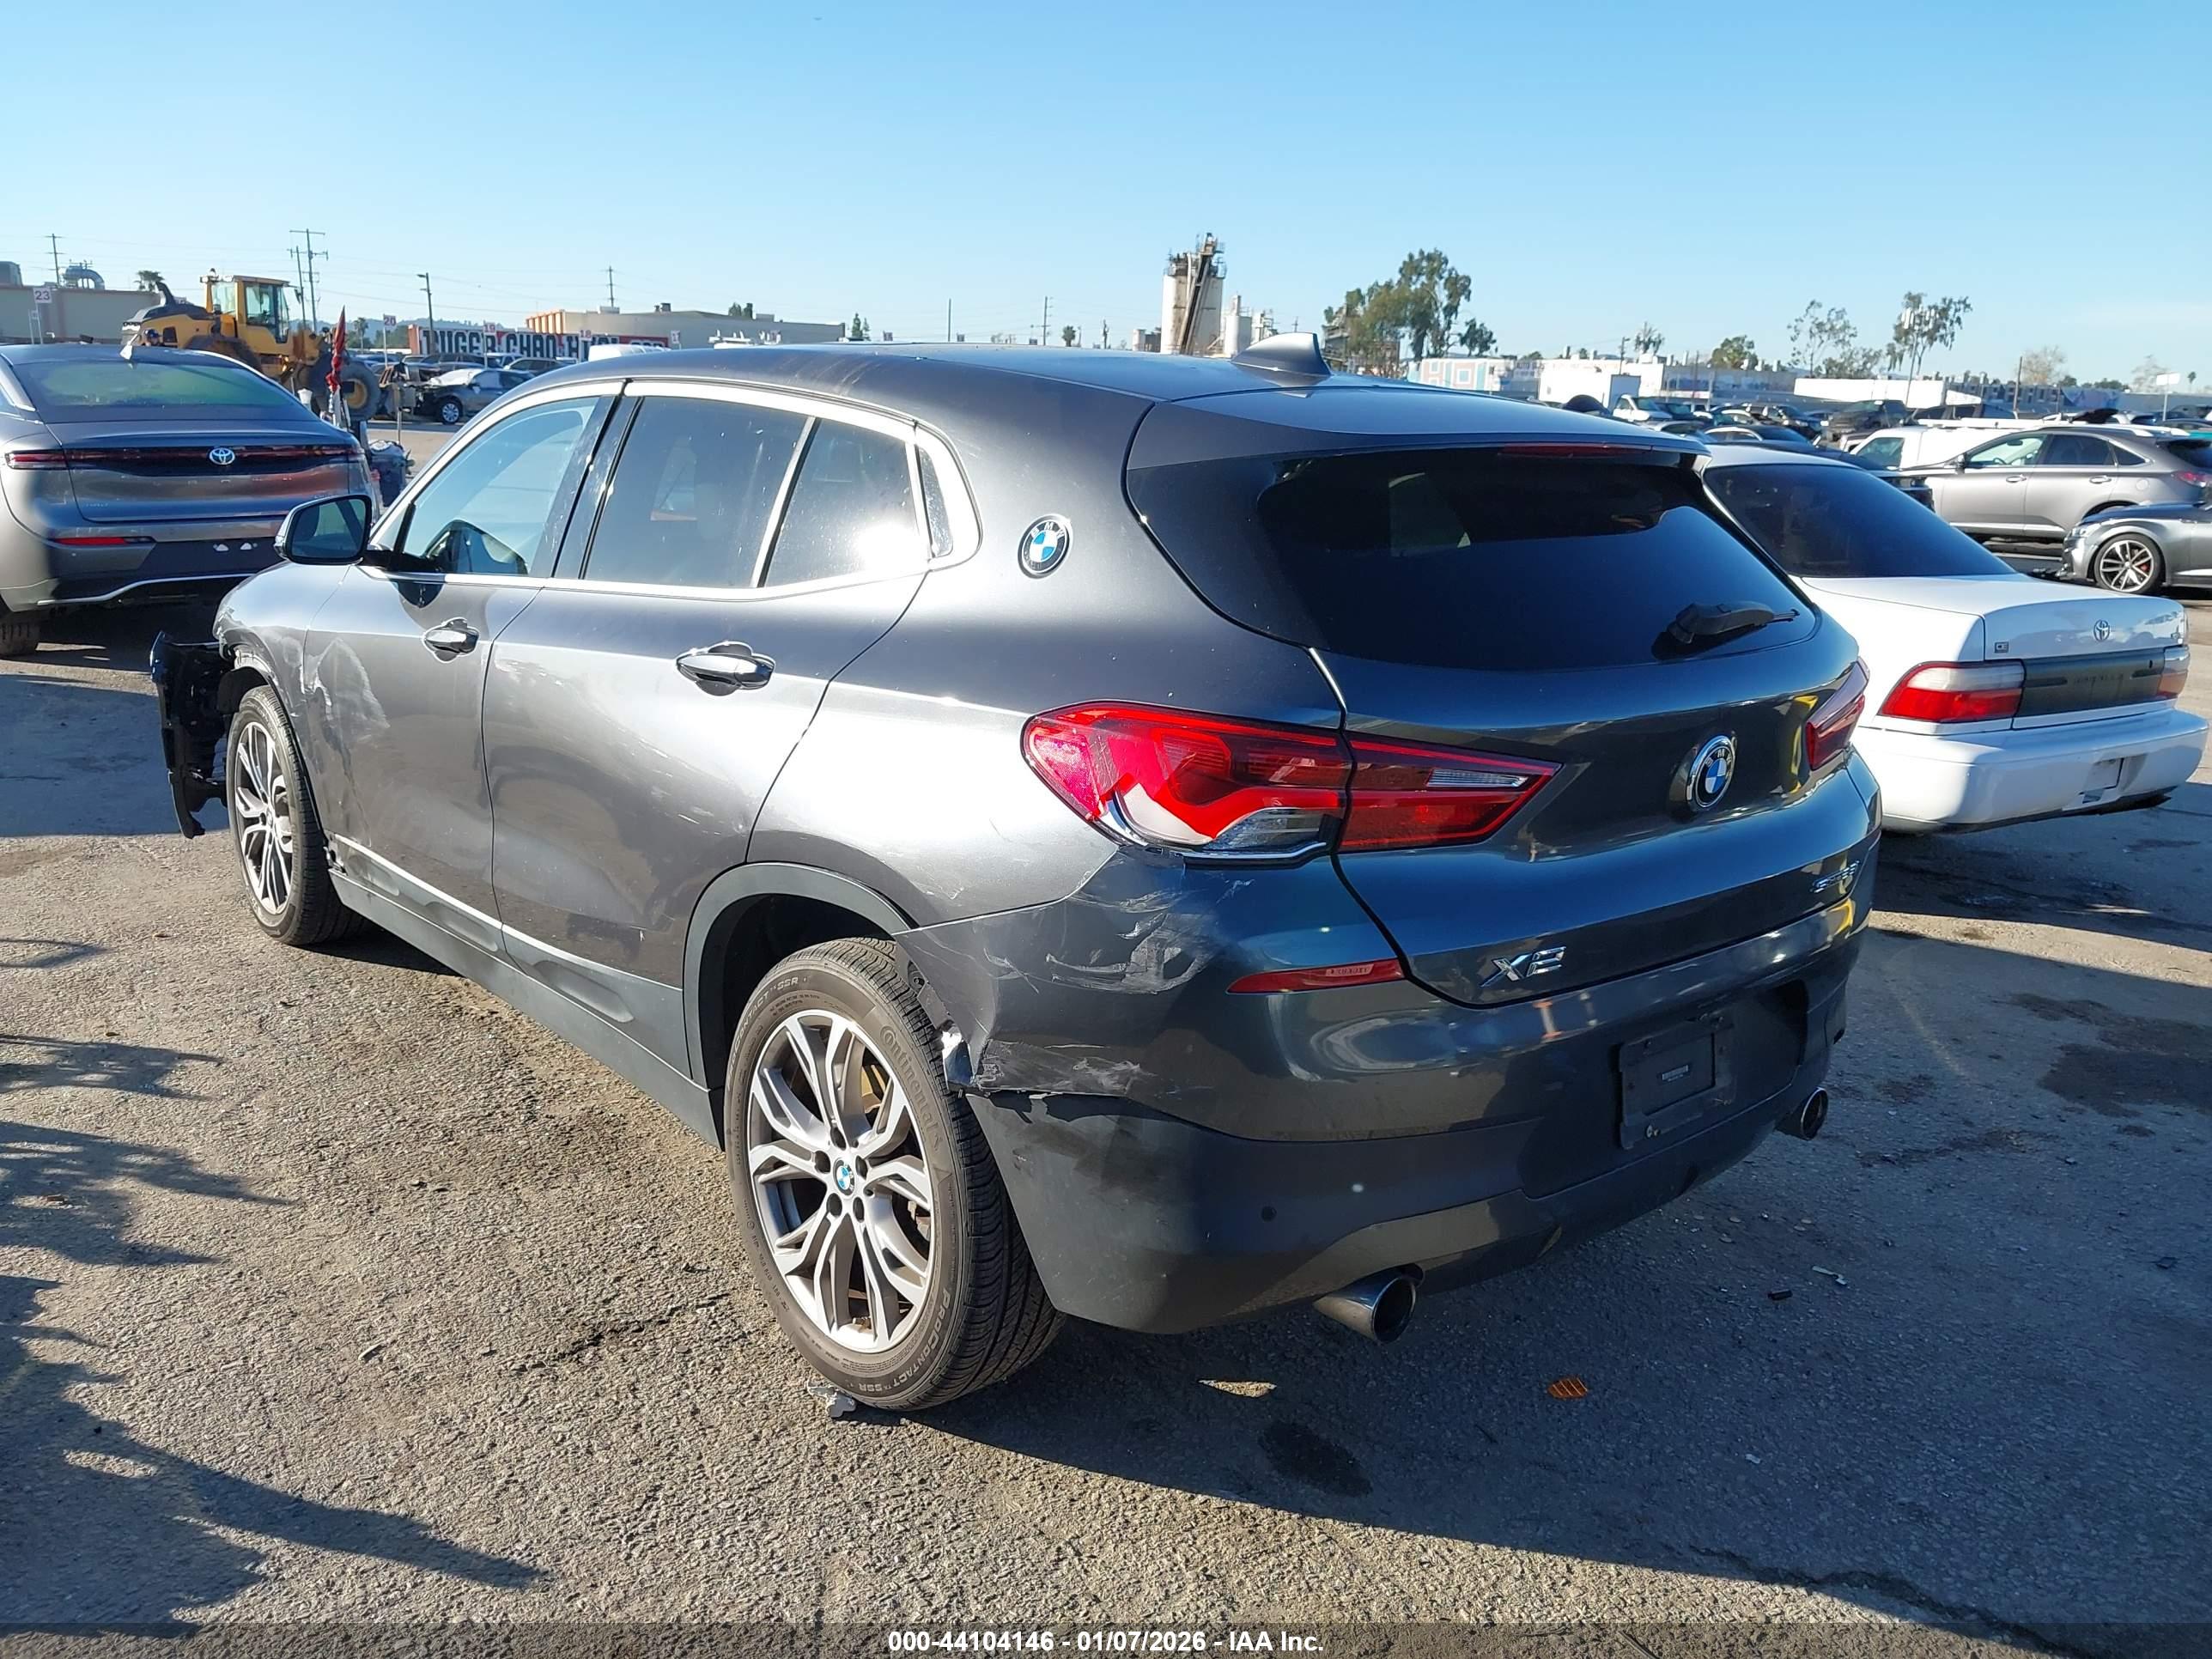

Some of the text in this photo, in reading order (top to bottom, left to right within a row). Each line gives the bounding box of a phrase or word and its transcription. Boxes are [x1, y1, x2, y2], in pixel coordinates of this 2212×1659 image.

[34, 290, 50, 301] 23
[384, 315, 397, 326] 20
[1030, 520, 1066, 539] BMW
[1704, 748, 1734, 768] BMW
[1480, 946, 1566, 988] X2
[880, 1025, 939, 1132] Continental
